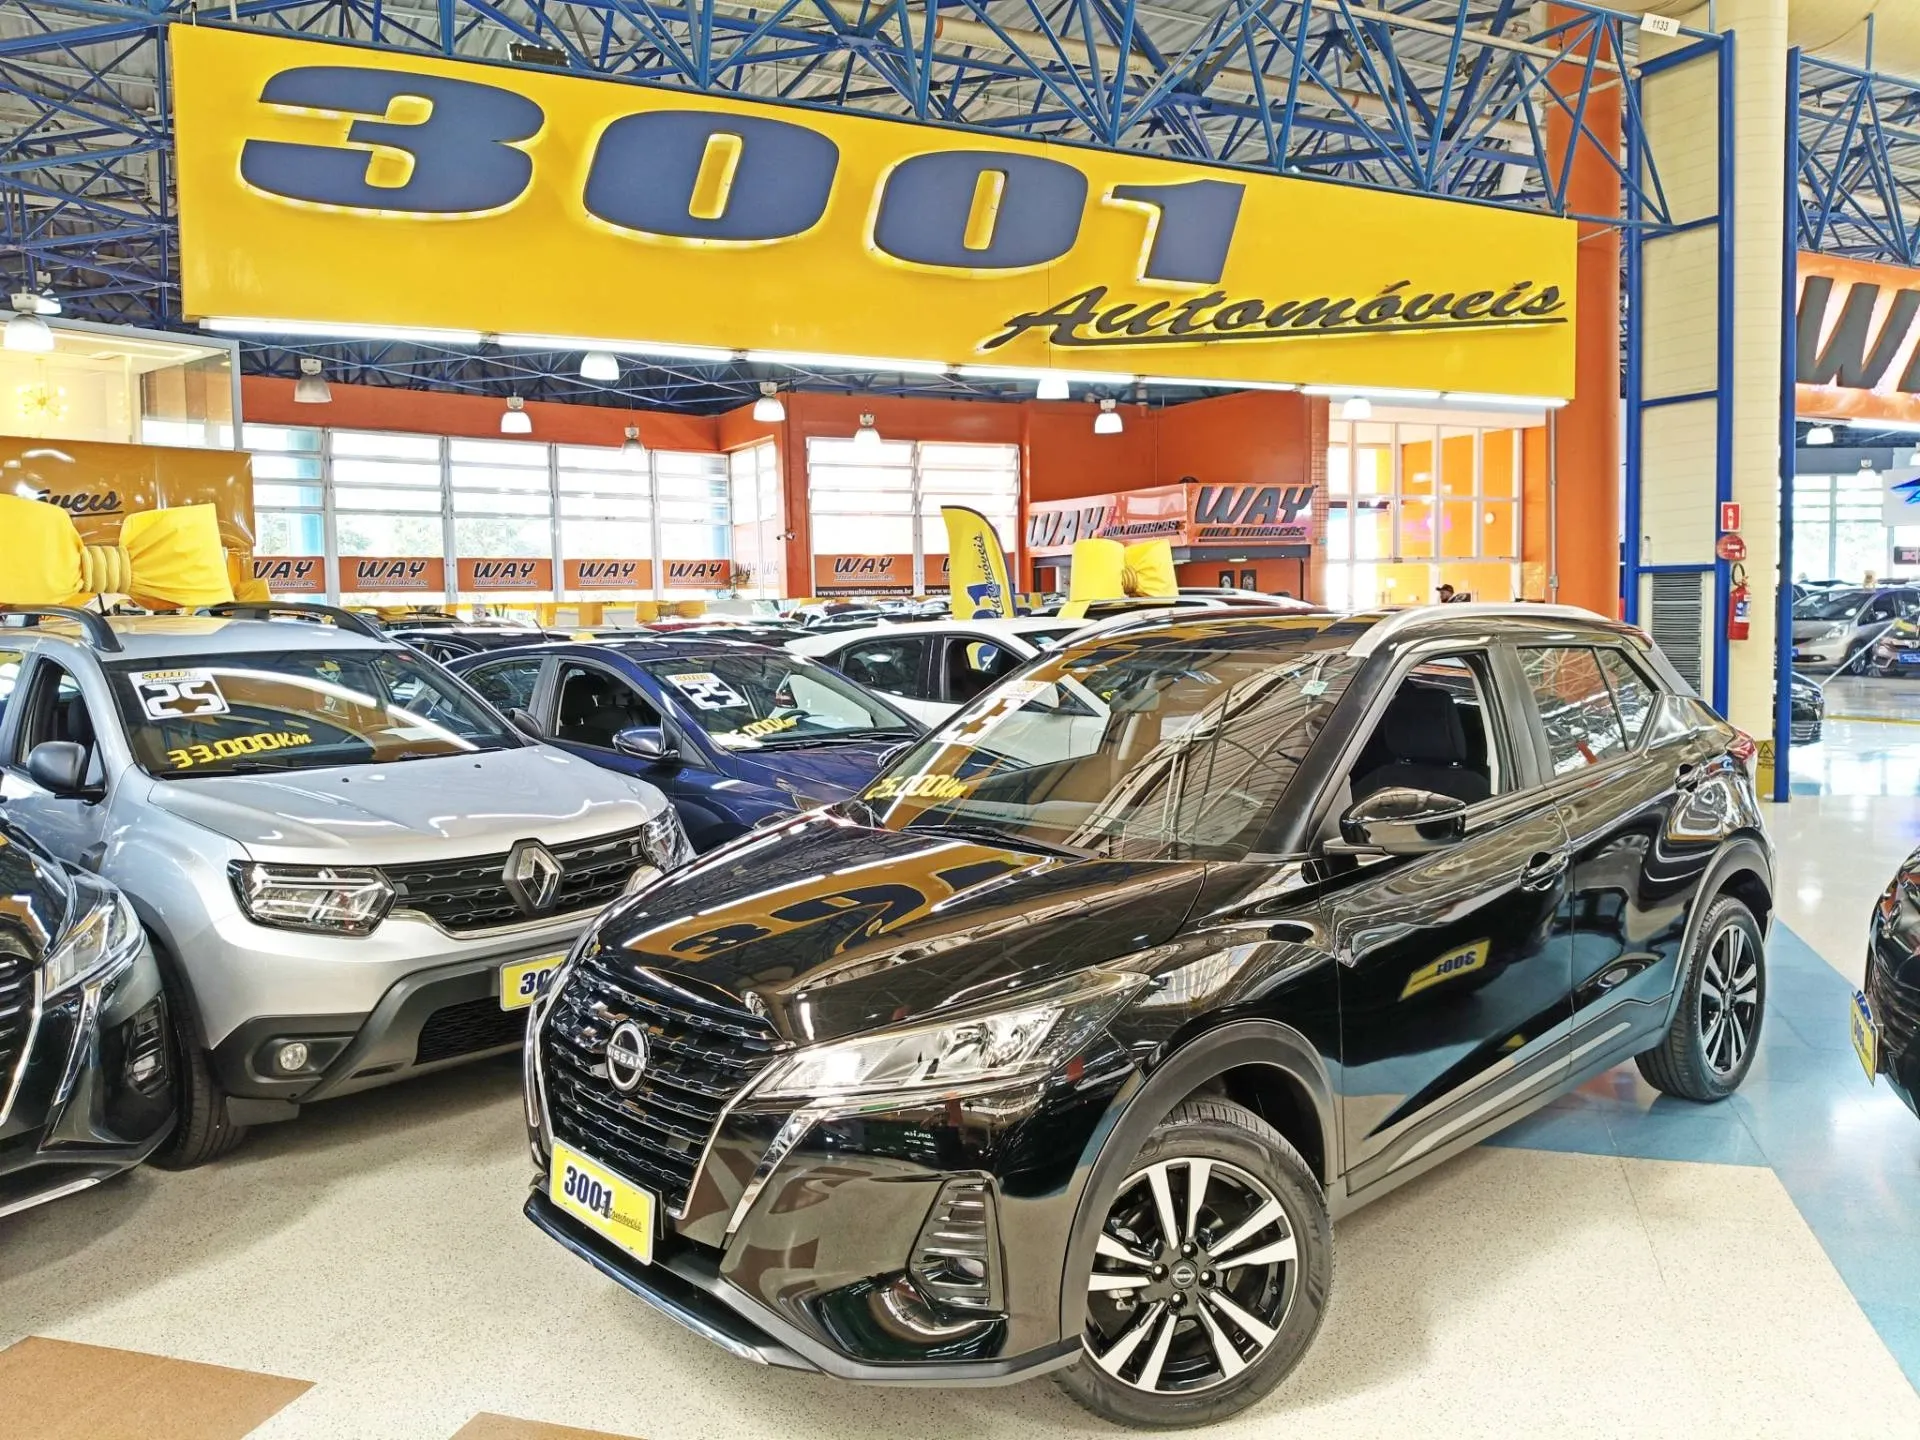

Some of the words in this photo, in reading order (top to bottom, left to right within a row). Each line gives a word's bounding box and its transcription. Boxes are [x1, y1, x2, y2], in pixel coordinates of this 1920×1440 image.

[240, 66, 1246, 284] 3001
[978, 280, 1567, 348] Automóveis
[1195, 486, 1315, 524] WAY
[1028, 506, 1105, 546] WAY
[357, 560, 427, 578] WAY
[473, 562, 536, 578] WAY
[579, 562, 637, 578] WAY
[669, 562, 722, 577] WAY
[834, 556, 894, 574] WAY
[146, 681, 224, 717] 25
[685, 682, 741, 707] 25
[520, 969, 552, 995] 30
[607, 1044, 647, 1071] NISSAN
[564, 1165, 612, 1219] 3001
